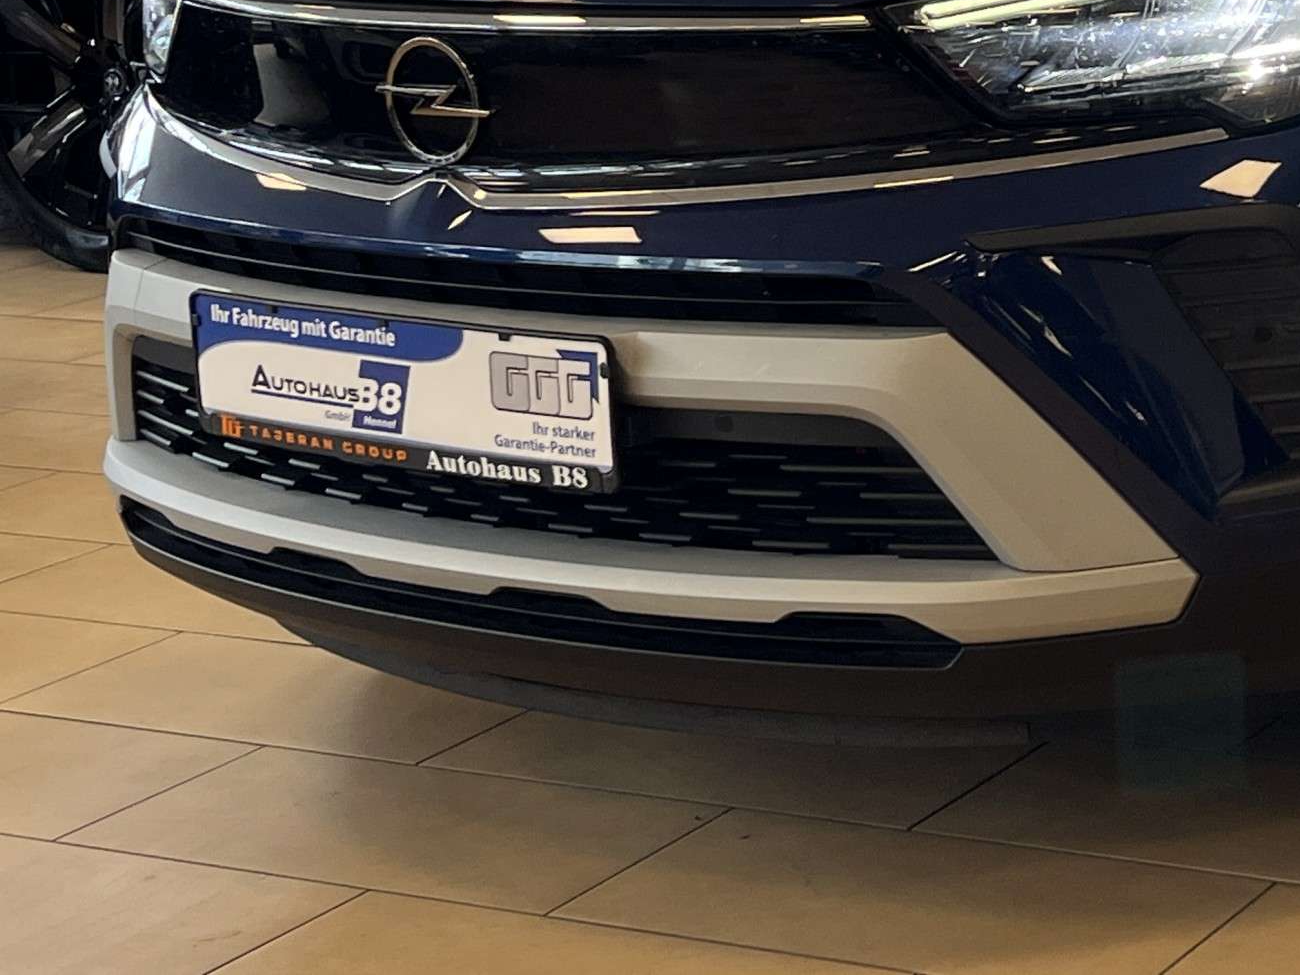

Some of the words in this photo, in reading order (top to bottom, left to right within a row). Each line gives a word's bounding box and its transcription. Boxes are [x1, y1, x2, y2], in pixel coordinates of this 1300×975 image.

[211, 304, 229, 323] Ihr
[232, 307, 299, 338] Fahrzeug
[302, 318, 326, 338] mit
[329, 321, 396, 346] Garantie
[494, 434, 596, 458] Garantie-Partner
[532, 421, 549, 435] Ihr
[552, 425, 596, 441] starker
[426, 450, 542, 483] Autohaus
[551, 464, 589, 489] B8
